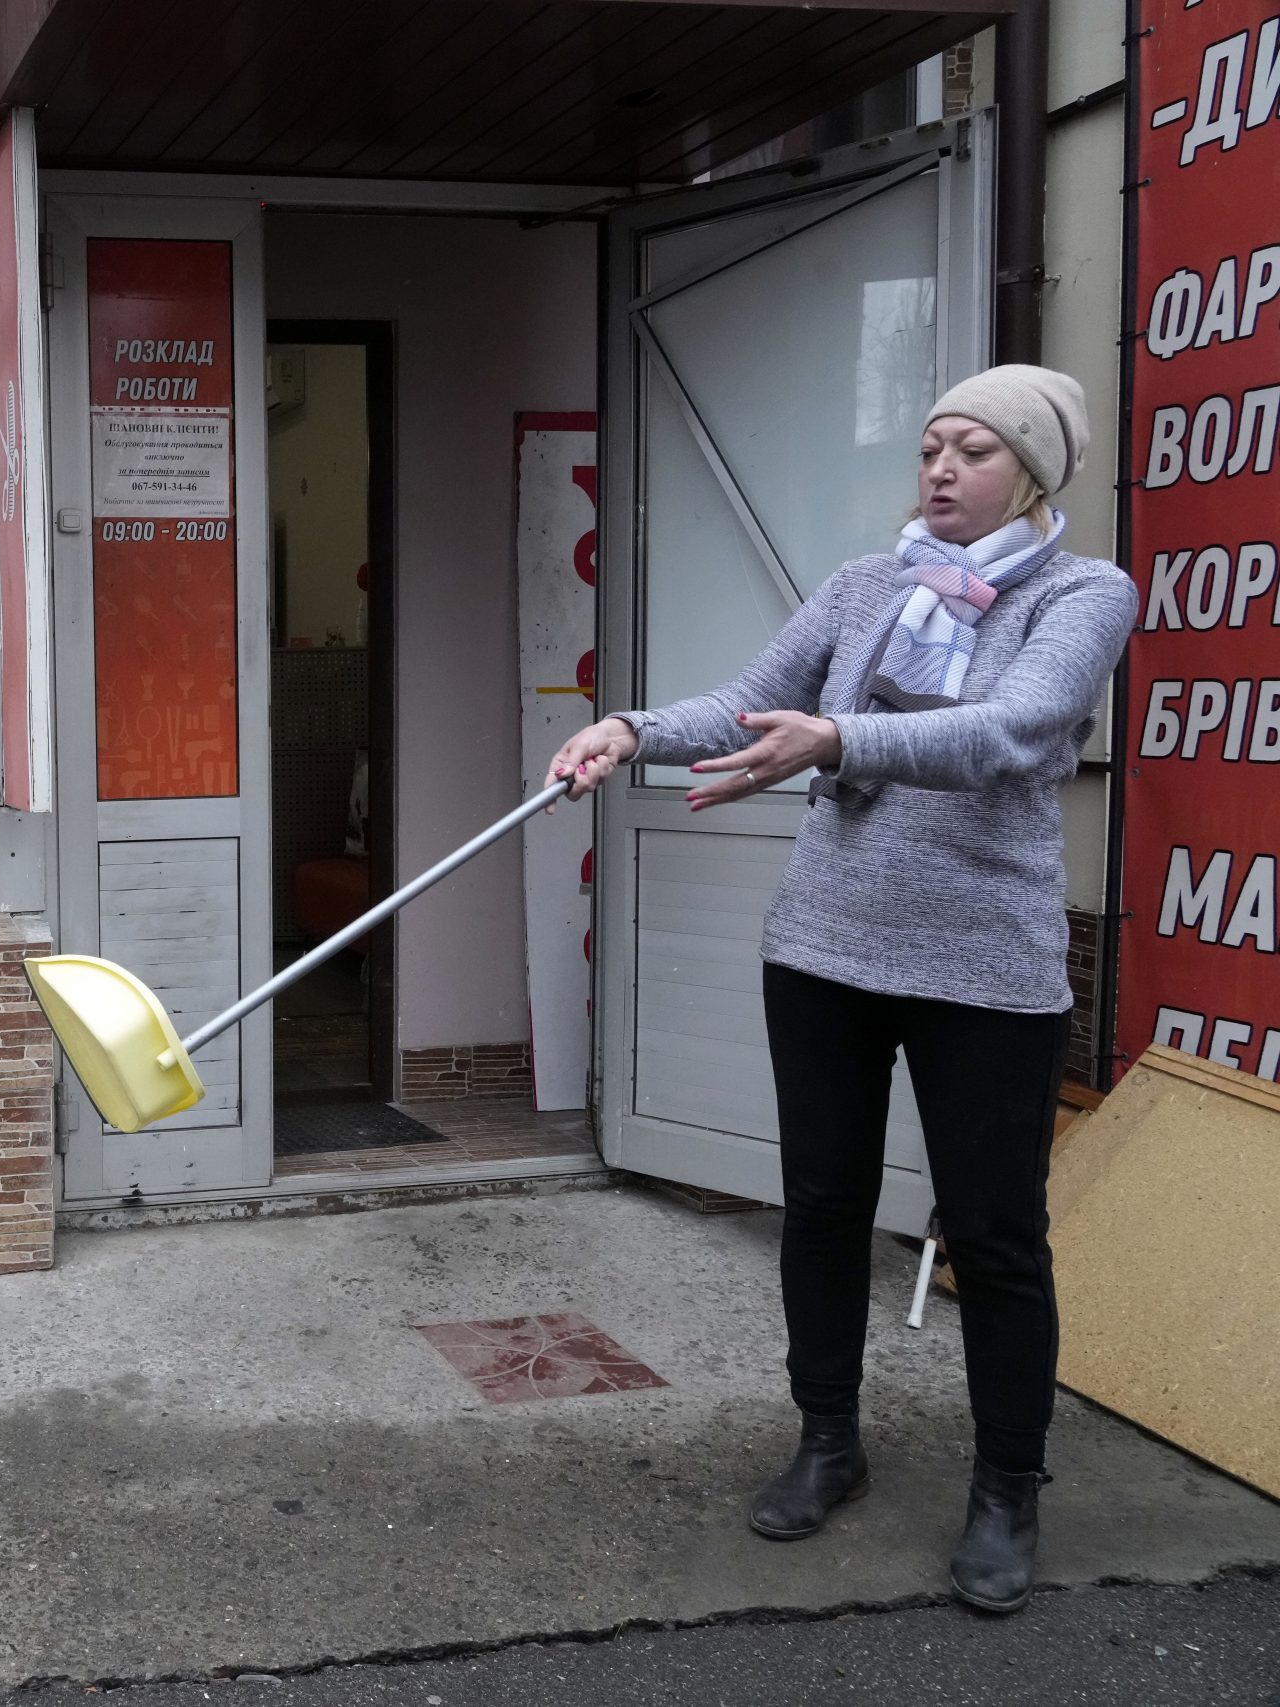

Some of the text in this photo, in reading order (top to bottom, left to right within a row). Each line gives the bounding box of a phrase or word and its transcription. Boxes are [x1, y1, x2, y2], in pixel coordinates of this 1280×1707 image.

[115, 340, 214, 366] РОЗКЛАД
[115, 377, 198, 401] РОБОТИ
[109, 423, 219, 434] ШАНОВНІ КЛІЄНТИ!
[131, 482, 197, 492] 067-591-34-46
[102, 521, 155, 541] 09:00
[175, 521, 227, 541] 20:00
[1144, 542, 1280, 632] КОР
